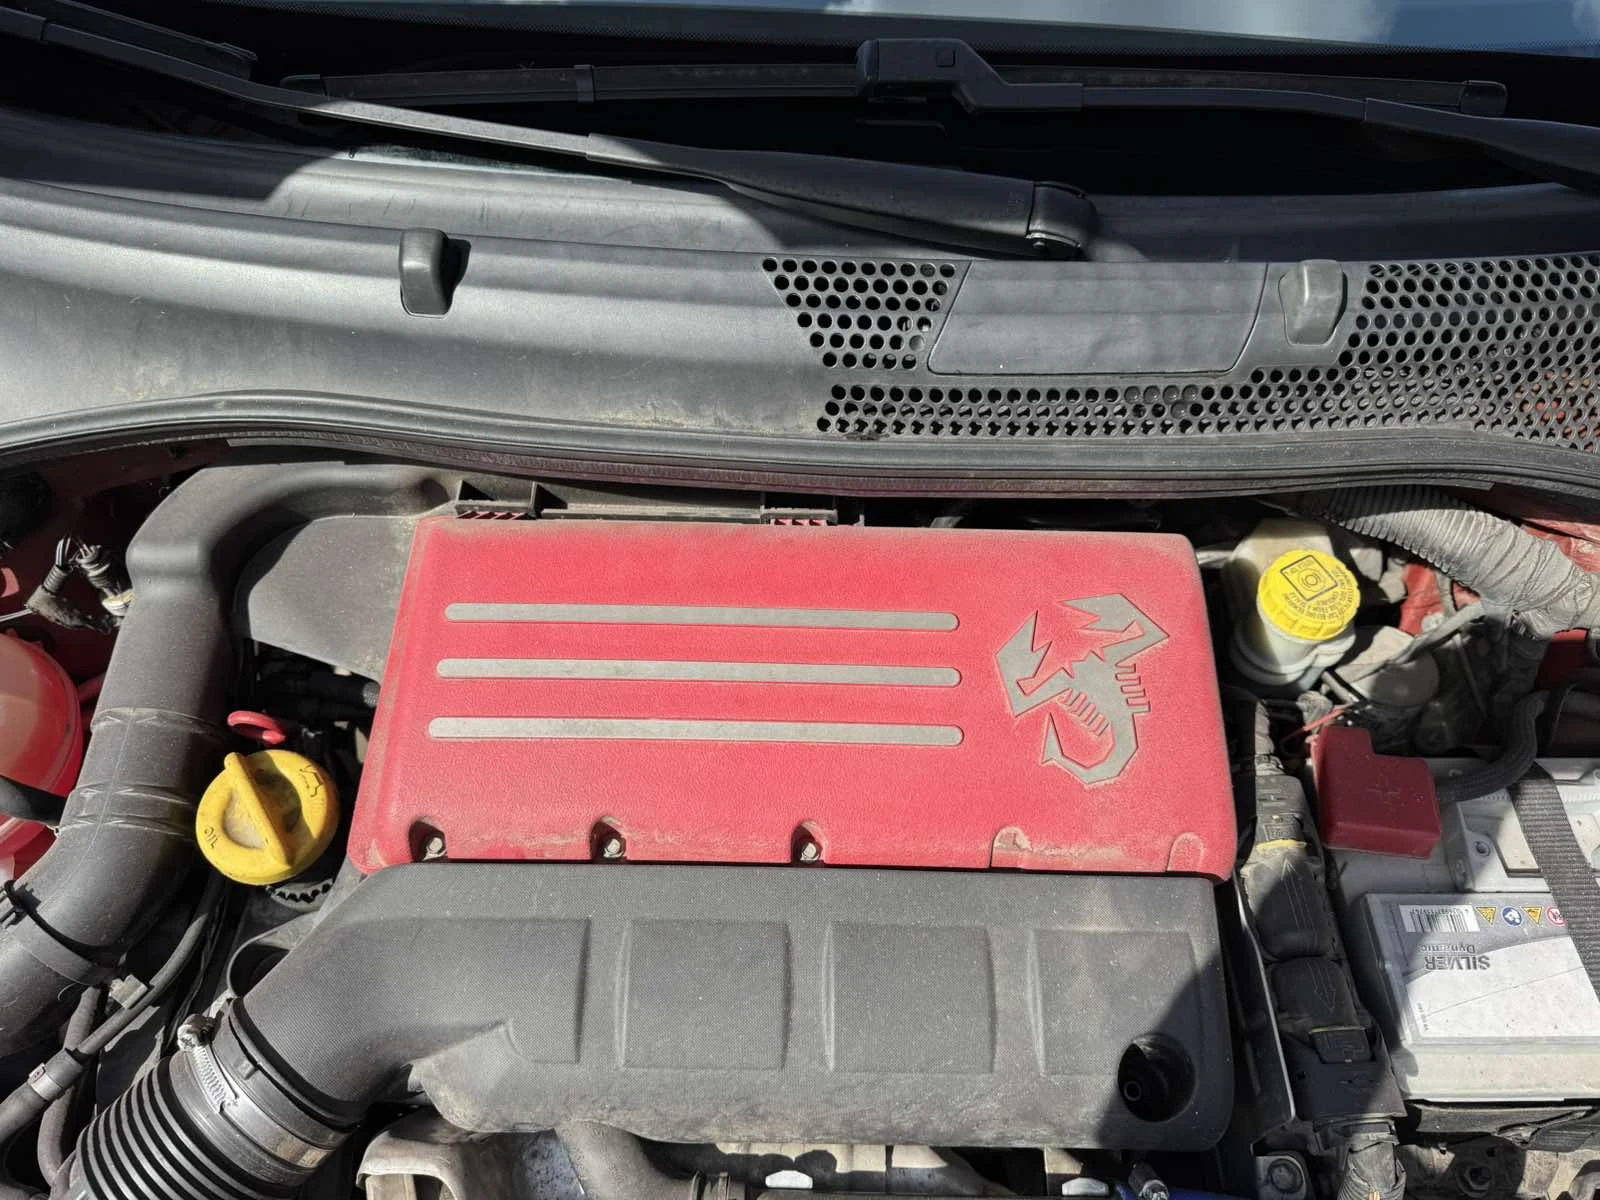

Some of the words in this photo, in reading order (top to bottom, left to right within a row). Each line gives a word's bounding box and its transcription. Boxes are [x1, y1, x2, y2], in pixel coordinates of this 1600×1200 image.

[204, 826, 218, 849] OIL
[1420, 943, 1476, 954] Dynamic
[1423, 955, 1491, 971] SILVER
